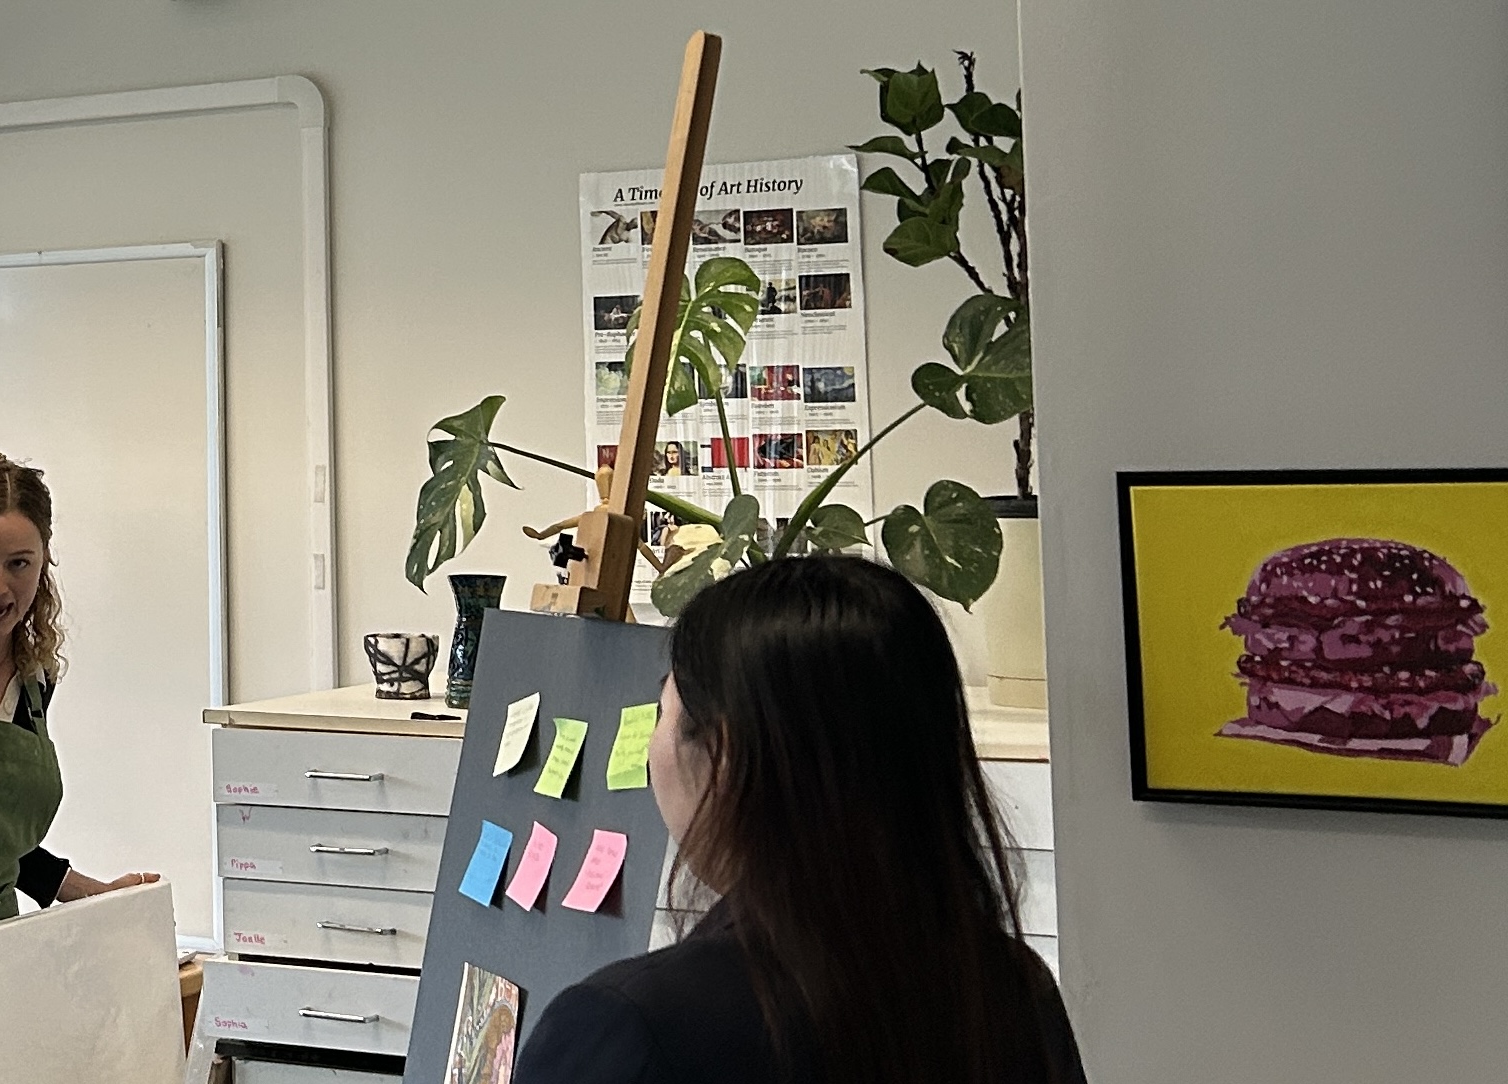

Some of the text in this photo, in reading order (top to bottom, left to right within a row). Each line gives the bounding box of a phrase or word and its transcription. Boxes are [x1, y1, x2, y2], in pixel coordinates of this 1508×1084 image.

[613, 177, 804, 202] A Tim of Art History
